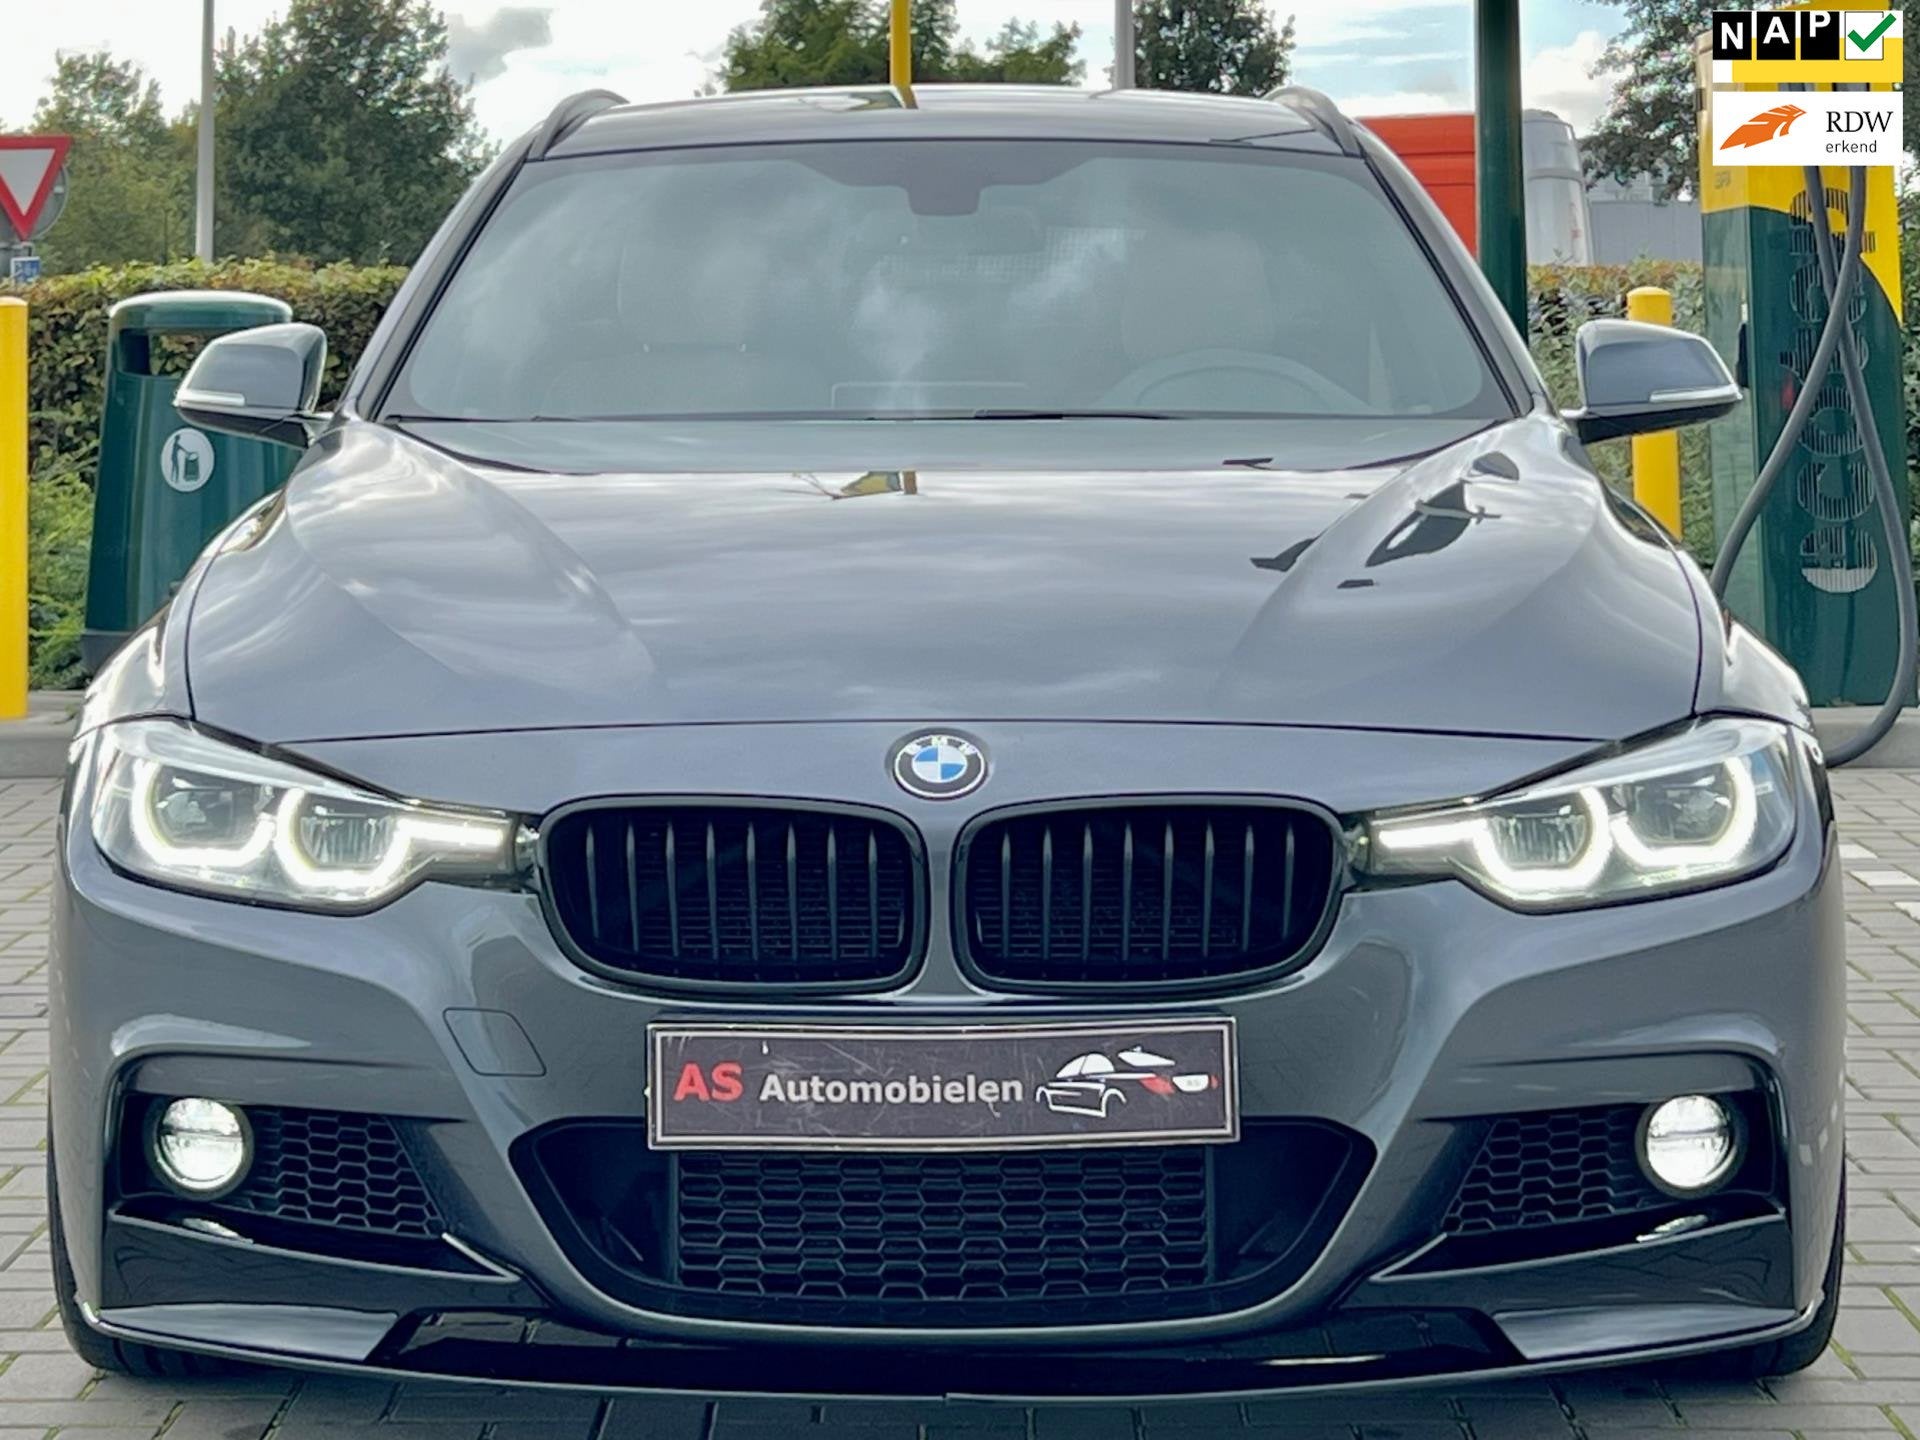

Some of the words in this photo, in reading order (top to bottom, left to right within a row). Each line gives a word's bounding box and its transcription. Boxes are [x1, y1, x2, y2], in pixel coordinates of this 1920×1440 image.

[902, 735, 978, 756] BMW
[674, 1062, 743, 1101] AS
[759, 1073, 1023, 1104] Automobielen
